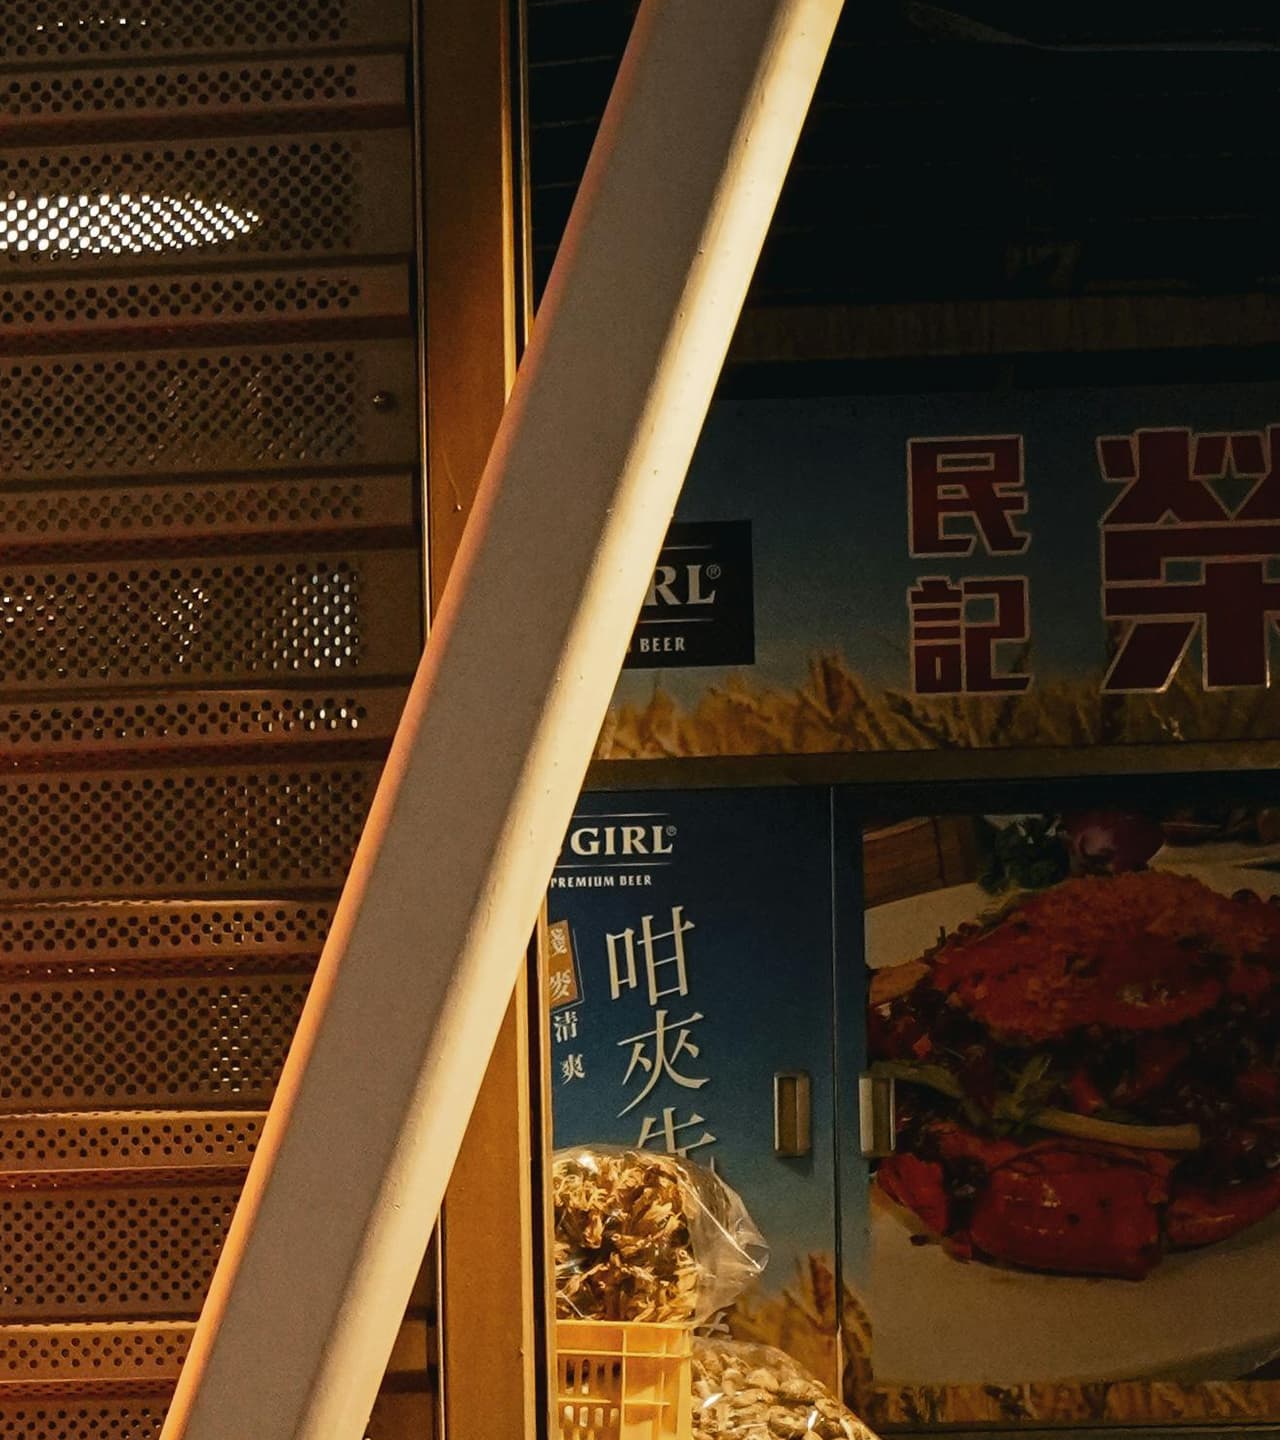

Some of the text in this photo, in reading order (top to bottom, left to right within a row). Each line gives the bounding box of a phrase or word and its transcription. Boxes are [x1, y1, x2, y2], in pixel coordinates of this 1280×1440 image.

[907, 432, 1033, 695] 民記
[645, 564, 717, 607] RL
[640, 636, 686, 653] BEER
[570, 824, 674, 856] GIRL
[550, 874, 653, 889] PREMIUM BEER
